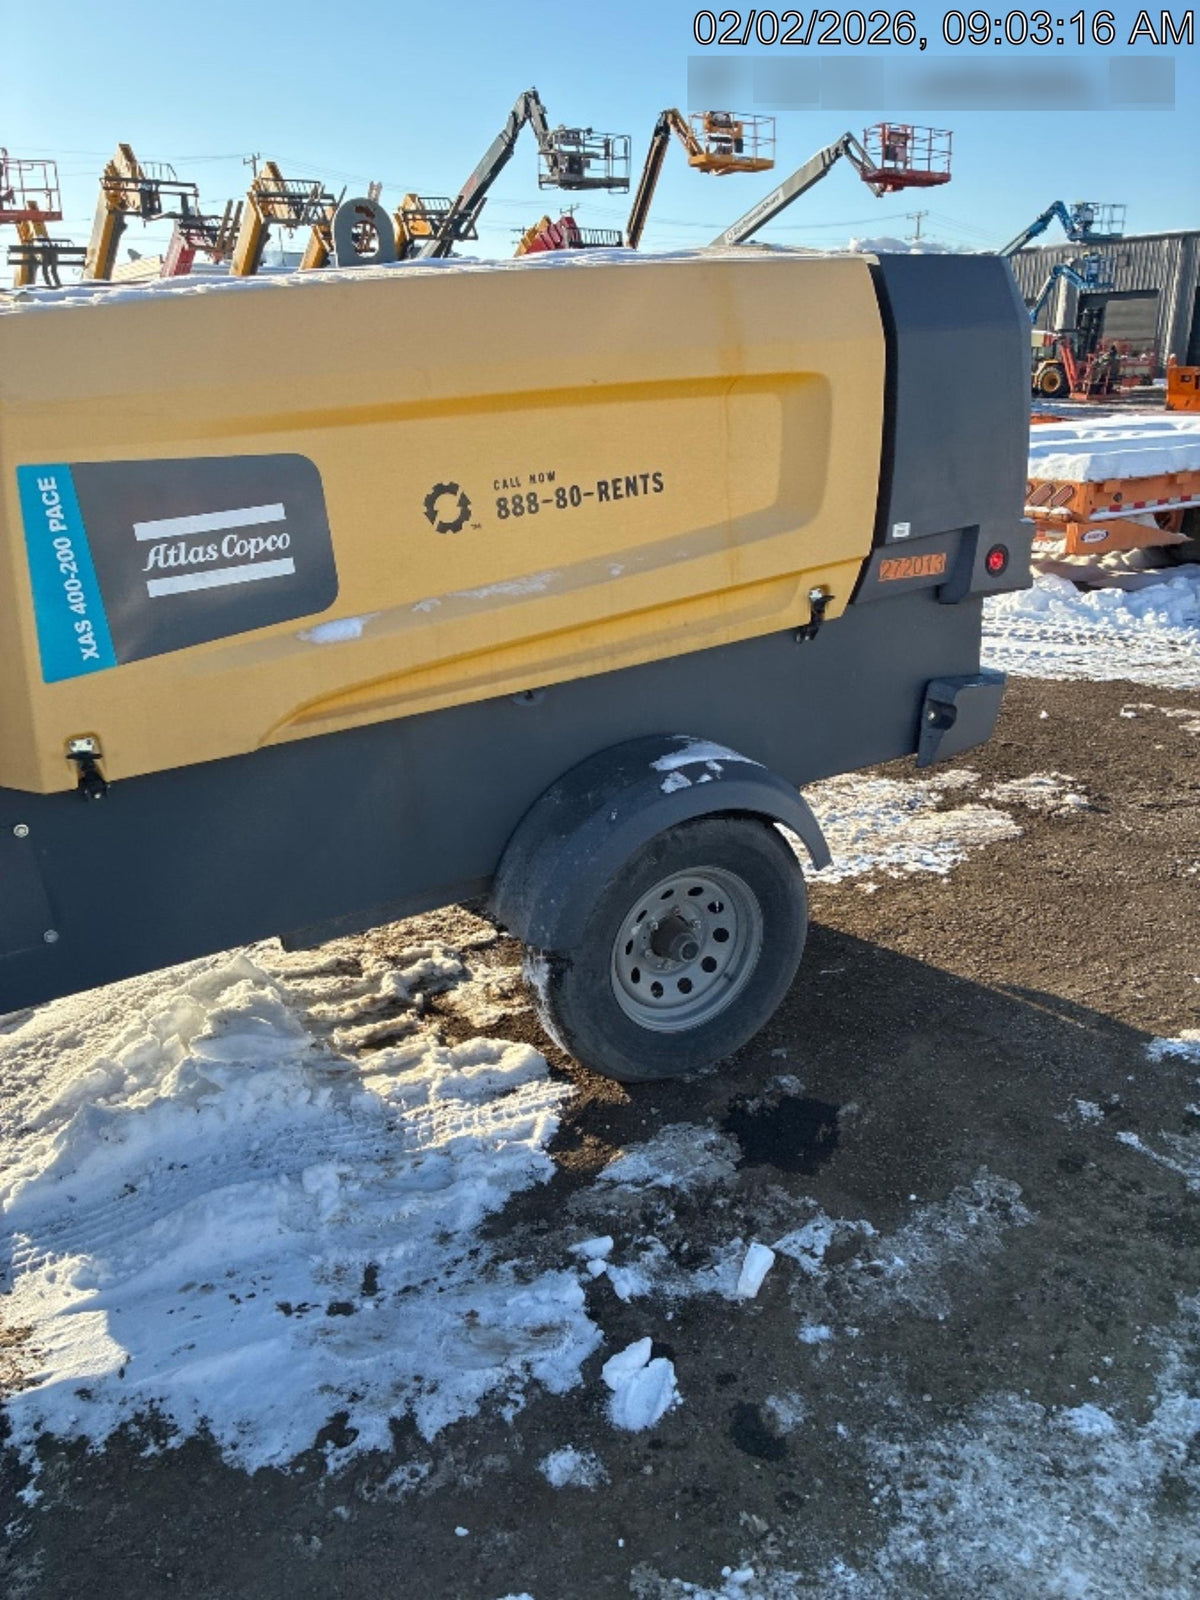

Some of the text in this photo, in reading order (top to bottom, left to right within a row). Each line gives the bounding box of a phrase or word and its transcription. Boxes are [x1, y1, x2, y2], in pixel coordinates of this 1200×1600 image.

[493, 470, 557, 491] CALL NOW
[495, 471, 665, 520] 888-80-RENTS
[37, 476, 100, 661] XAS 400-200 PACE
[142, 532, 291, 572] Atlas Copco
[881, 553, 945, 580] 272013
